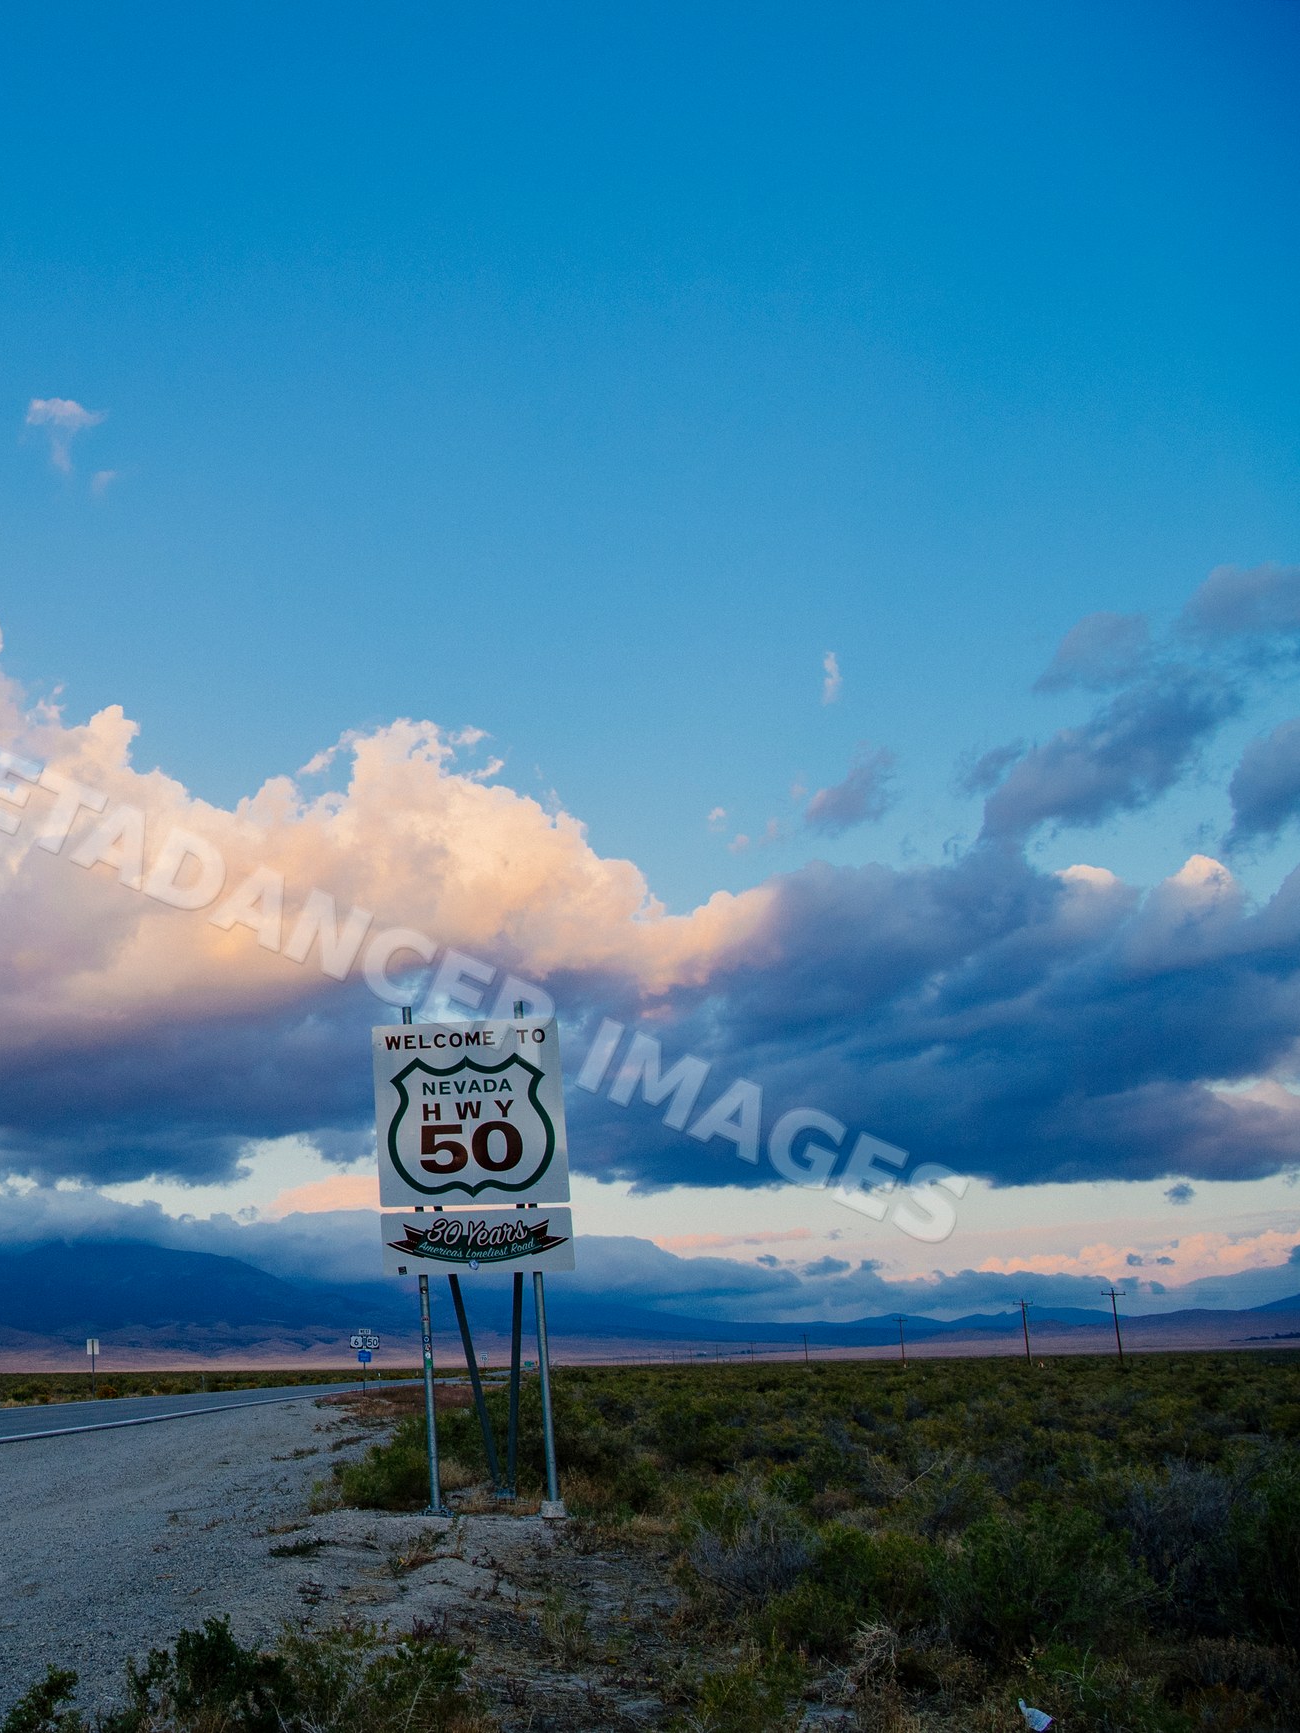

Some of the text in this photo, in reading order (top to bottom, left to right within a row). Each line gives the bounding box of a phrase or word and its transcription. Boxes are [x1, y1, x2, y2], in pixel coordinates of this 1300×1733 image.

[385, 1028, 546, 1051] WELCOME TO
[422, 1078, 513, 1096] NEVADA
[422, 1099, 514, 1121] HWY
[420, 1121, 523, 1174] 50
[427, 1218, 528, 1247] 30 Years
[419, 1238, 536, 1258] America's Loneliest Road
